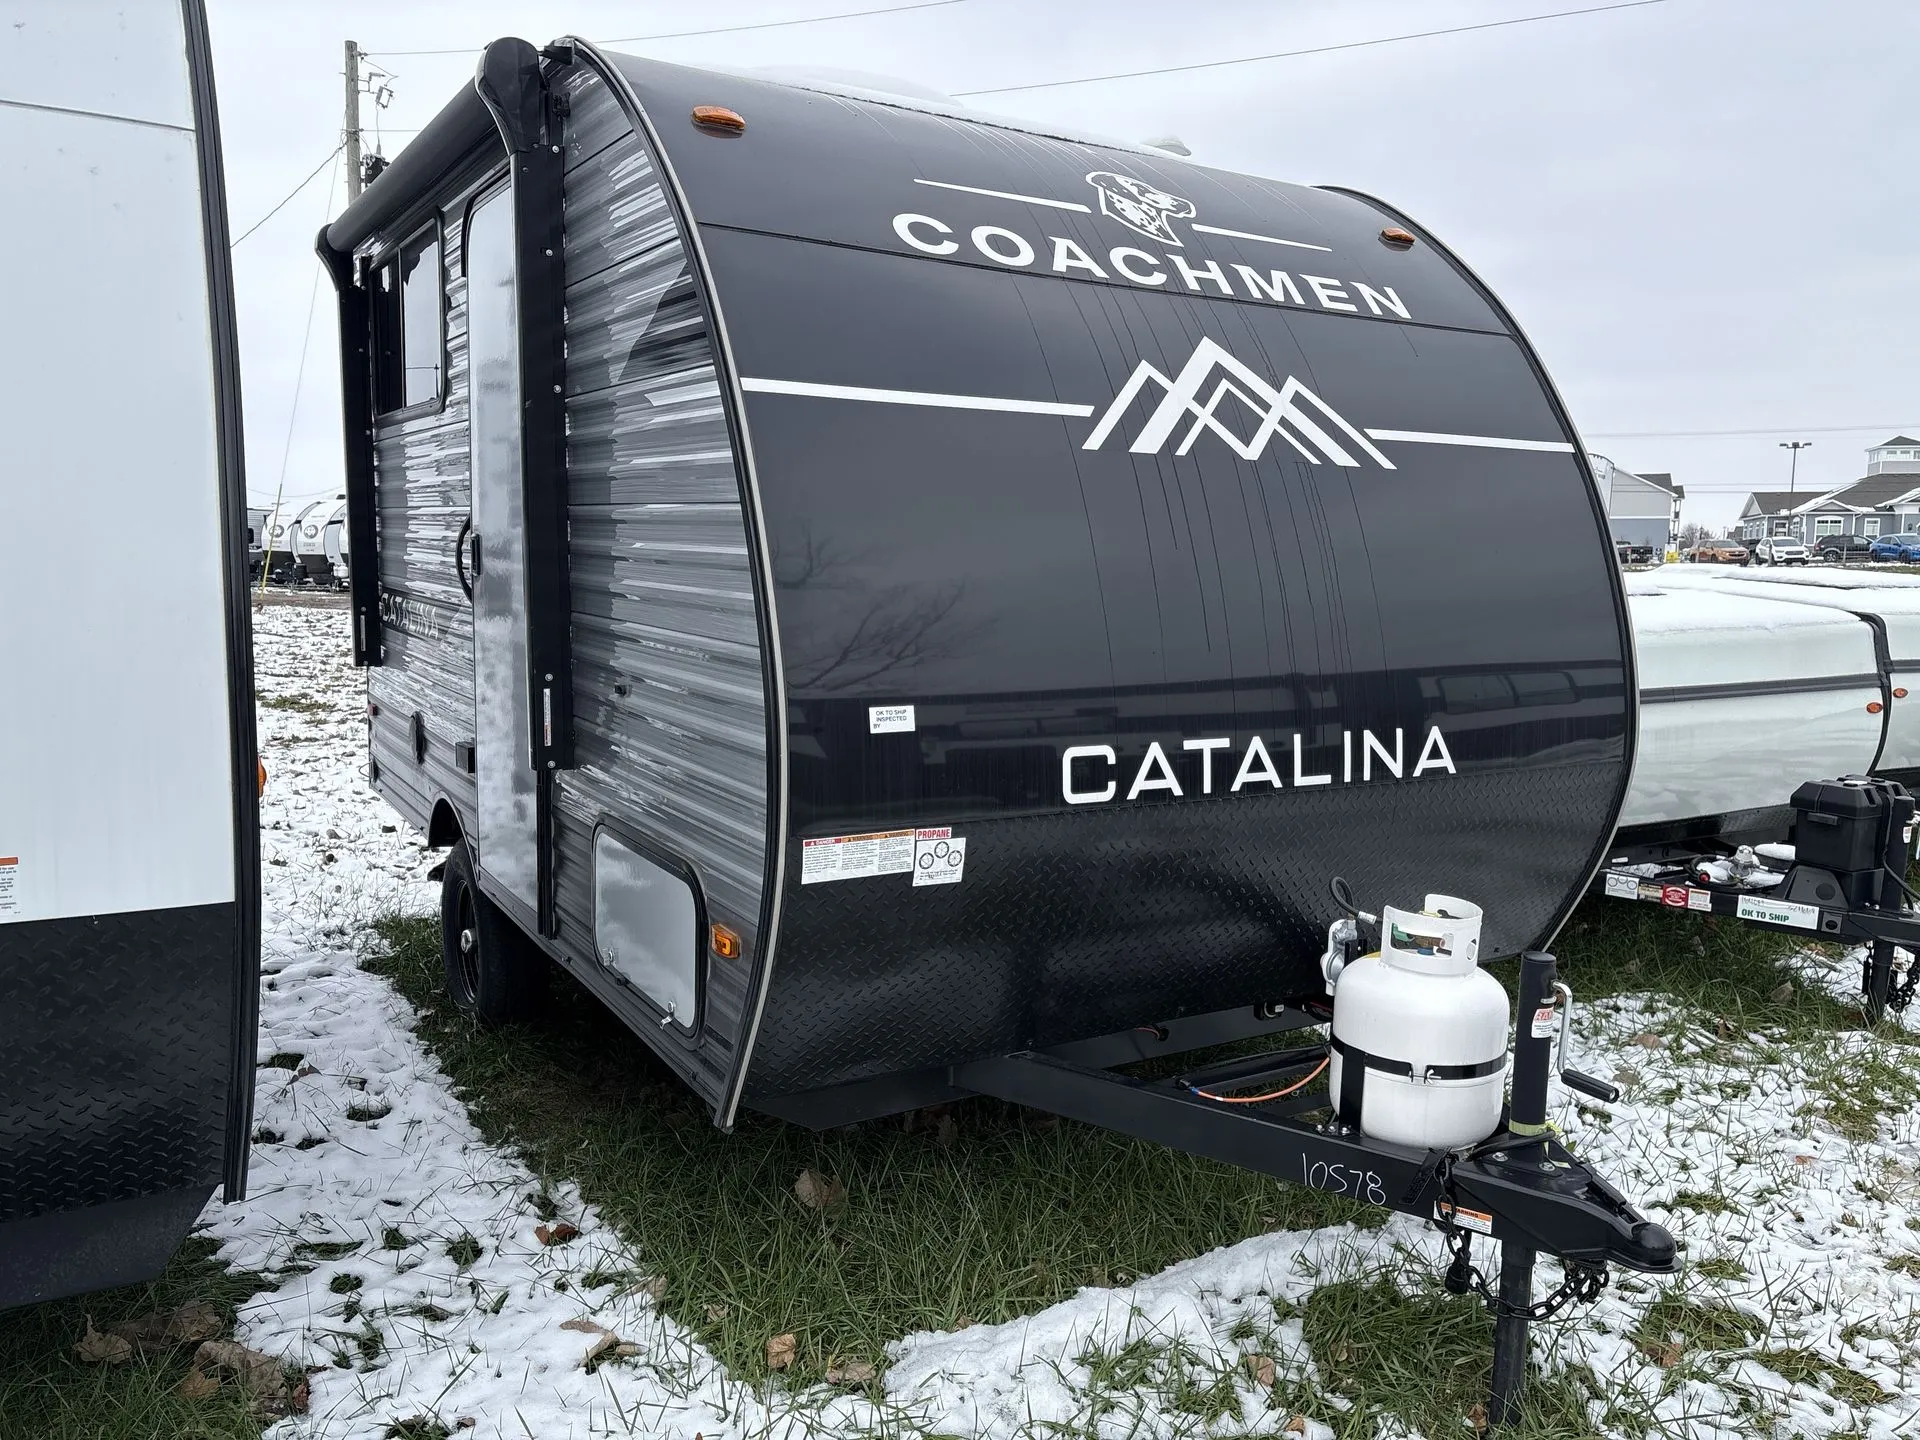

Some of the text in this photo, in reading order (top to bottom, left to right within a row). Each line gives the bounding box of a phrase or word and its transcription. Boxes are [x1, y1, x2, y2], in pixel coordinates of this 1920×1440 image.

[892, 213, 1413, 320] COACHMEN
[381, 592, 439, 639] CATALINA
[1062, 725, 1457, 805] CATALINA
[917, 829, 950, 840] PROPANE
[1741, 908, 1790, 923] OK TO SHIP
[1455, 1207, 1479, 1219] ARNING
